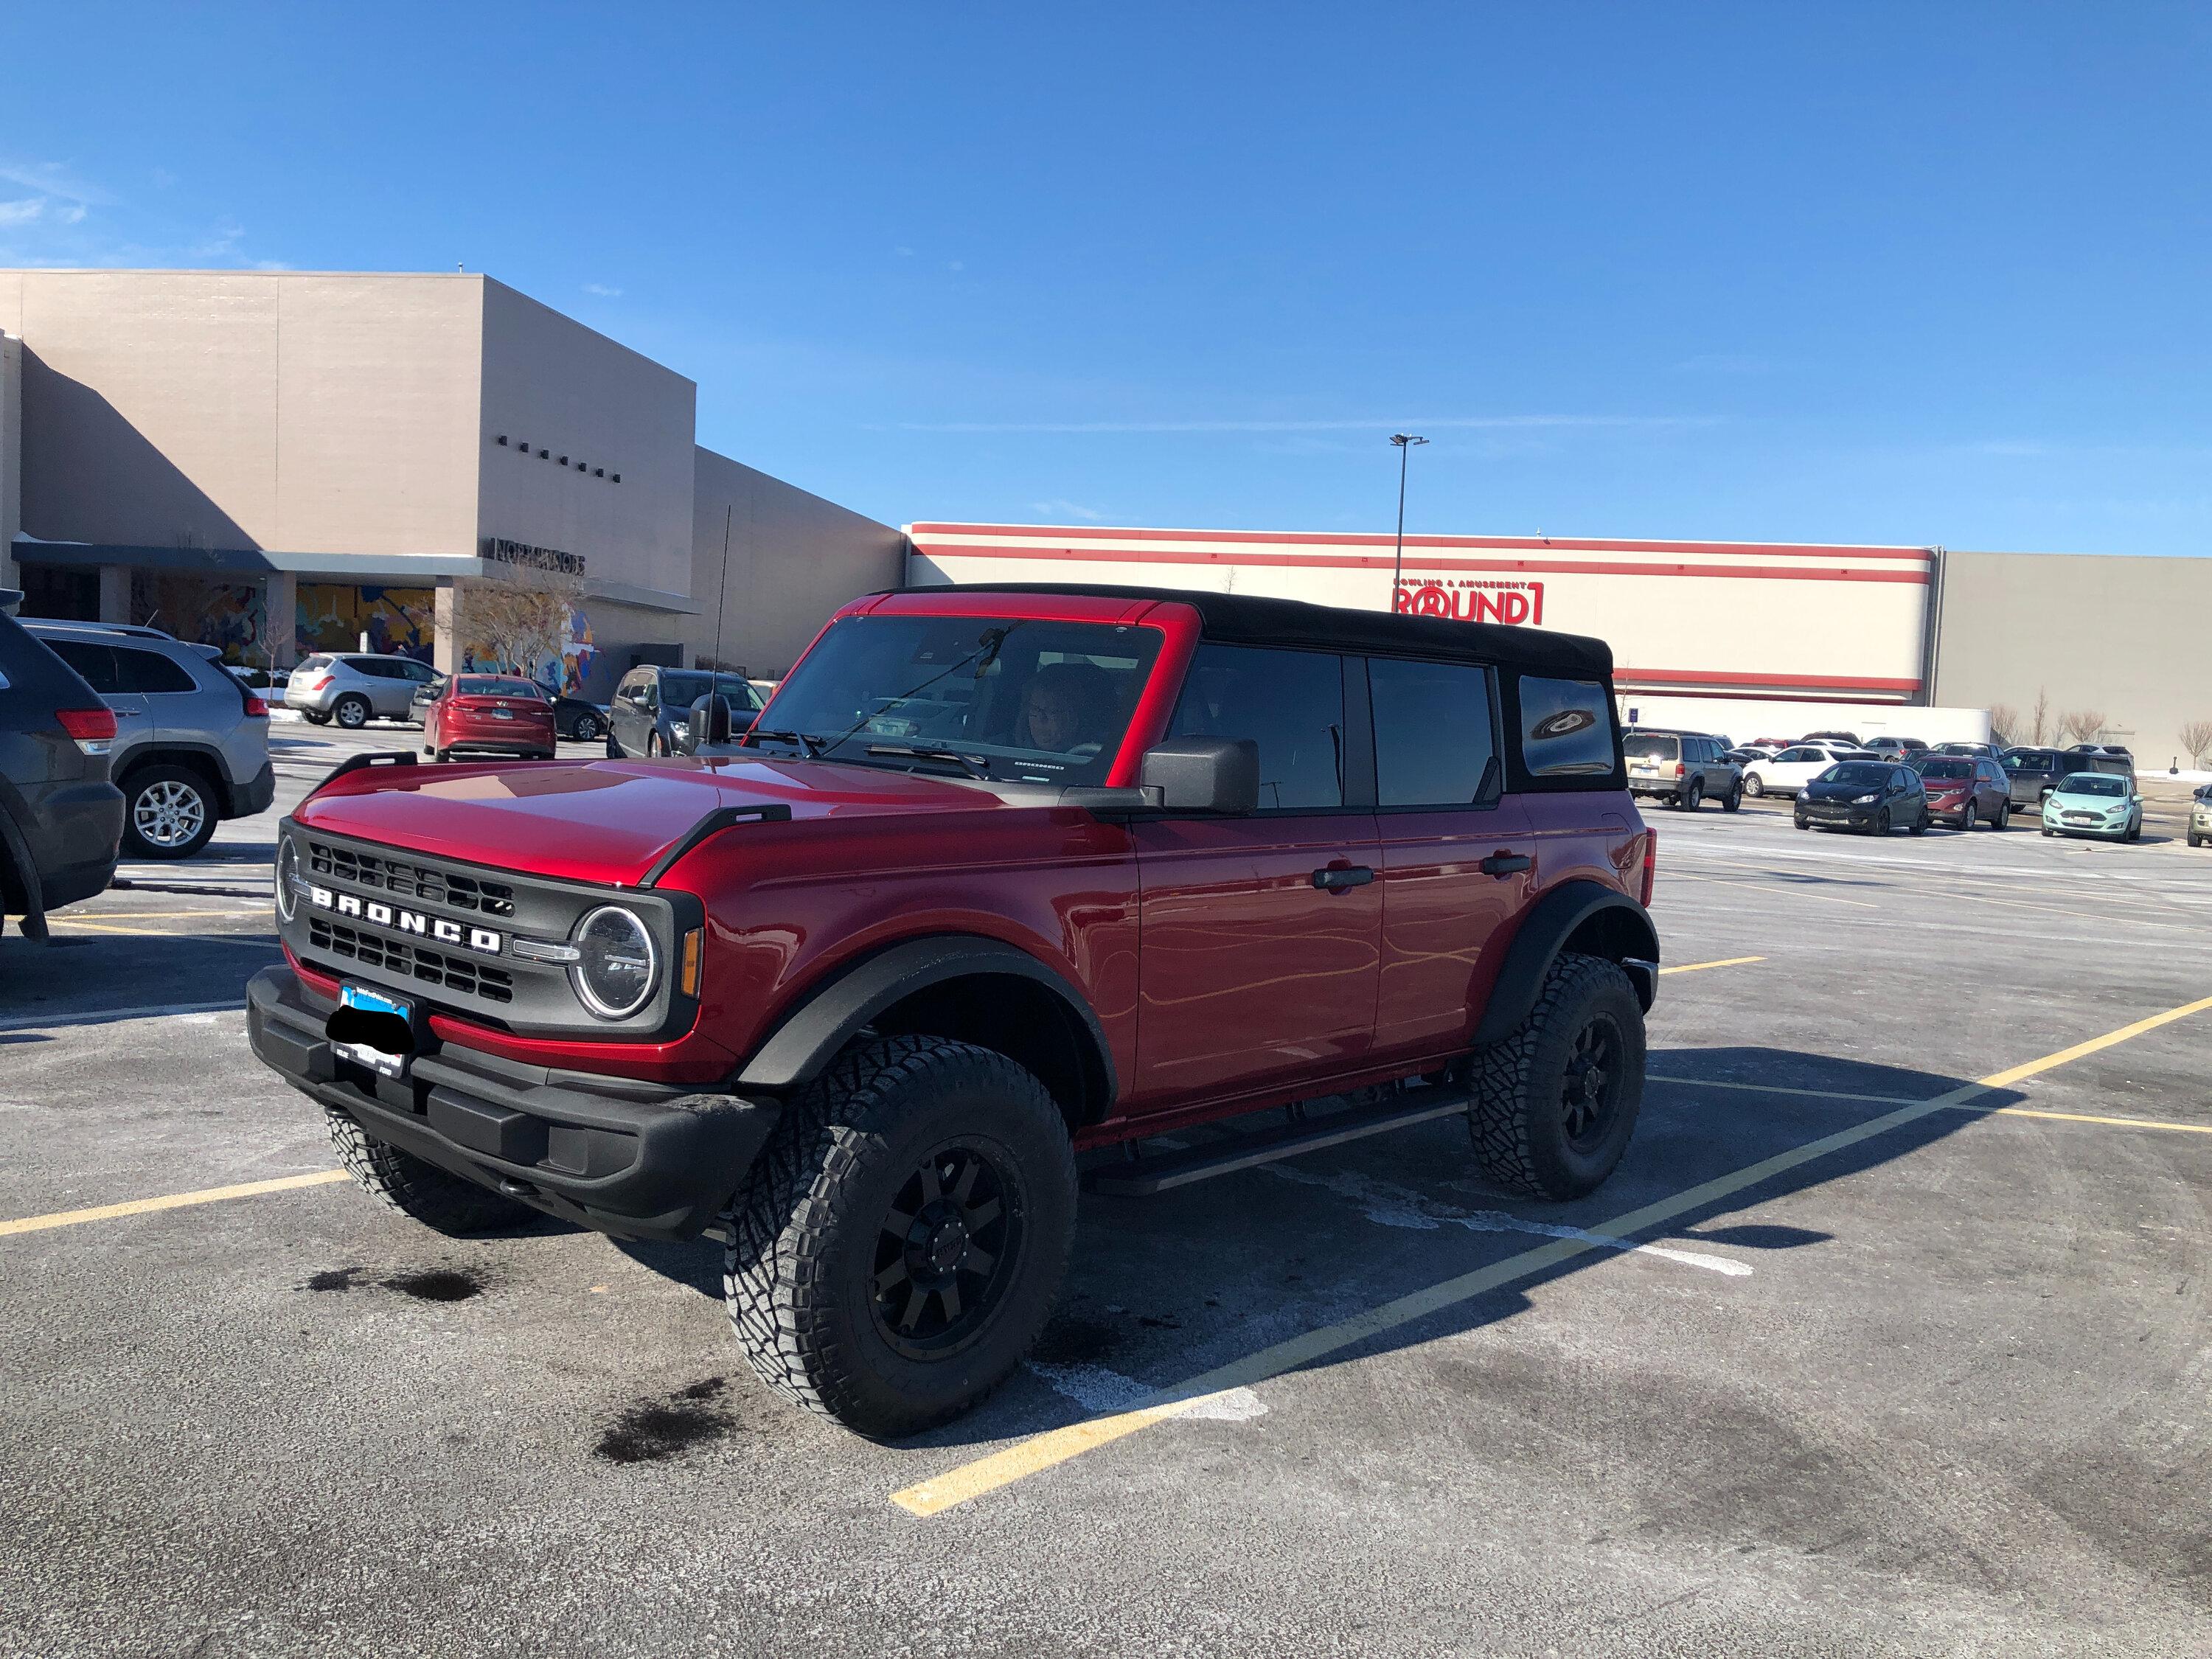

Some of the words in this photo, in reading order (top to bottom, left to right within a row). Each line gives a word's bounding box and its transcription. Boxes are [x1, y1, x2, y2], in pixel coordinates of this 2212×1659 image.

[1447, 580, 1455, 588] &
[1458, 580, 1528, 589] AMUSEMENT
[312, 886, 501, 952] BRONCO
